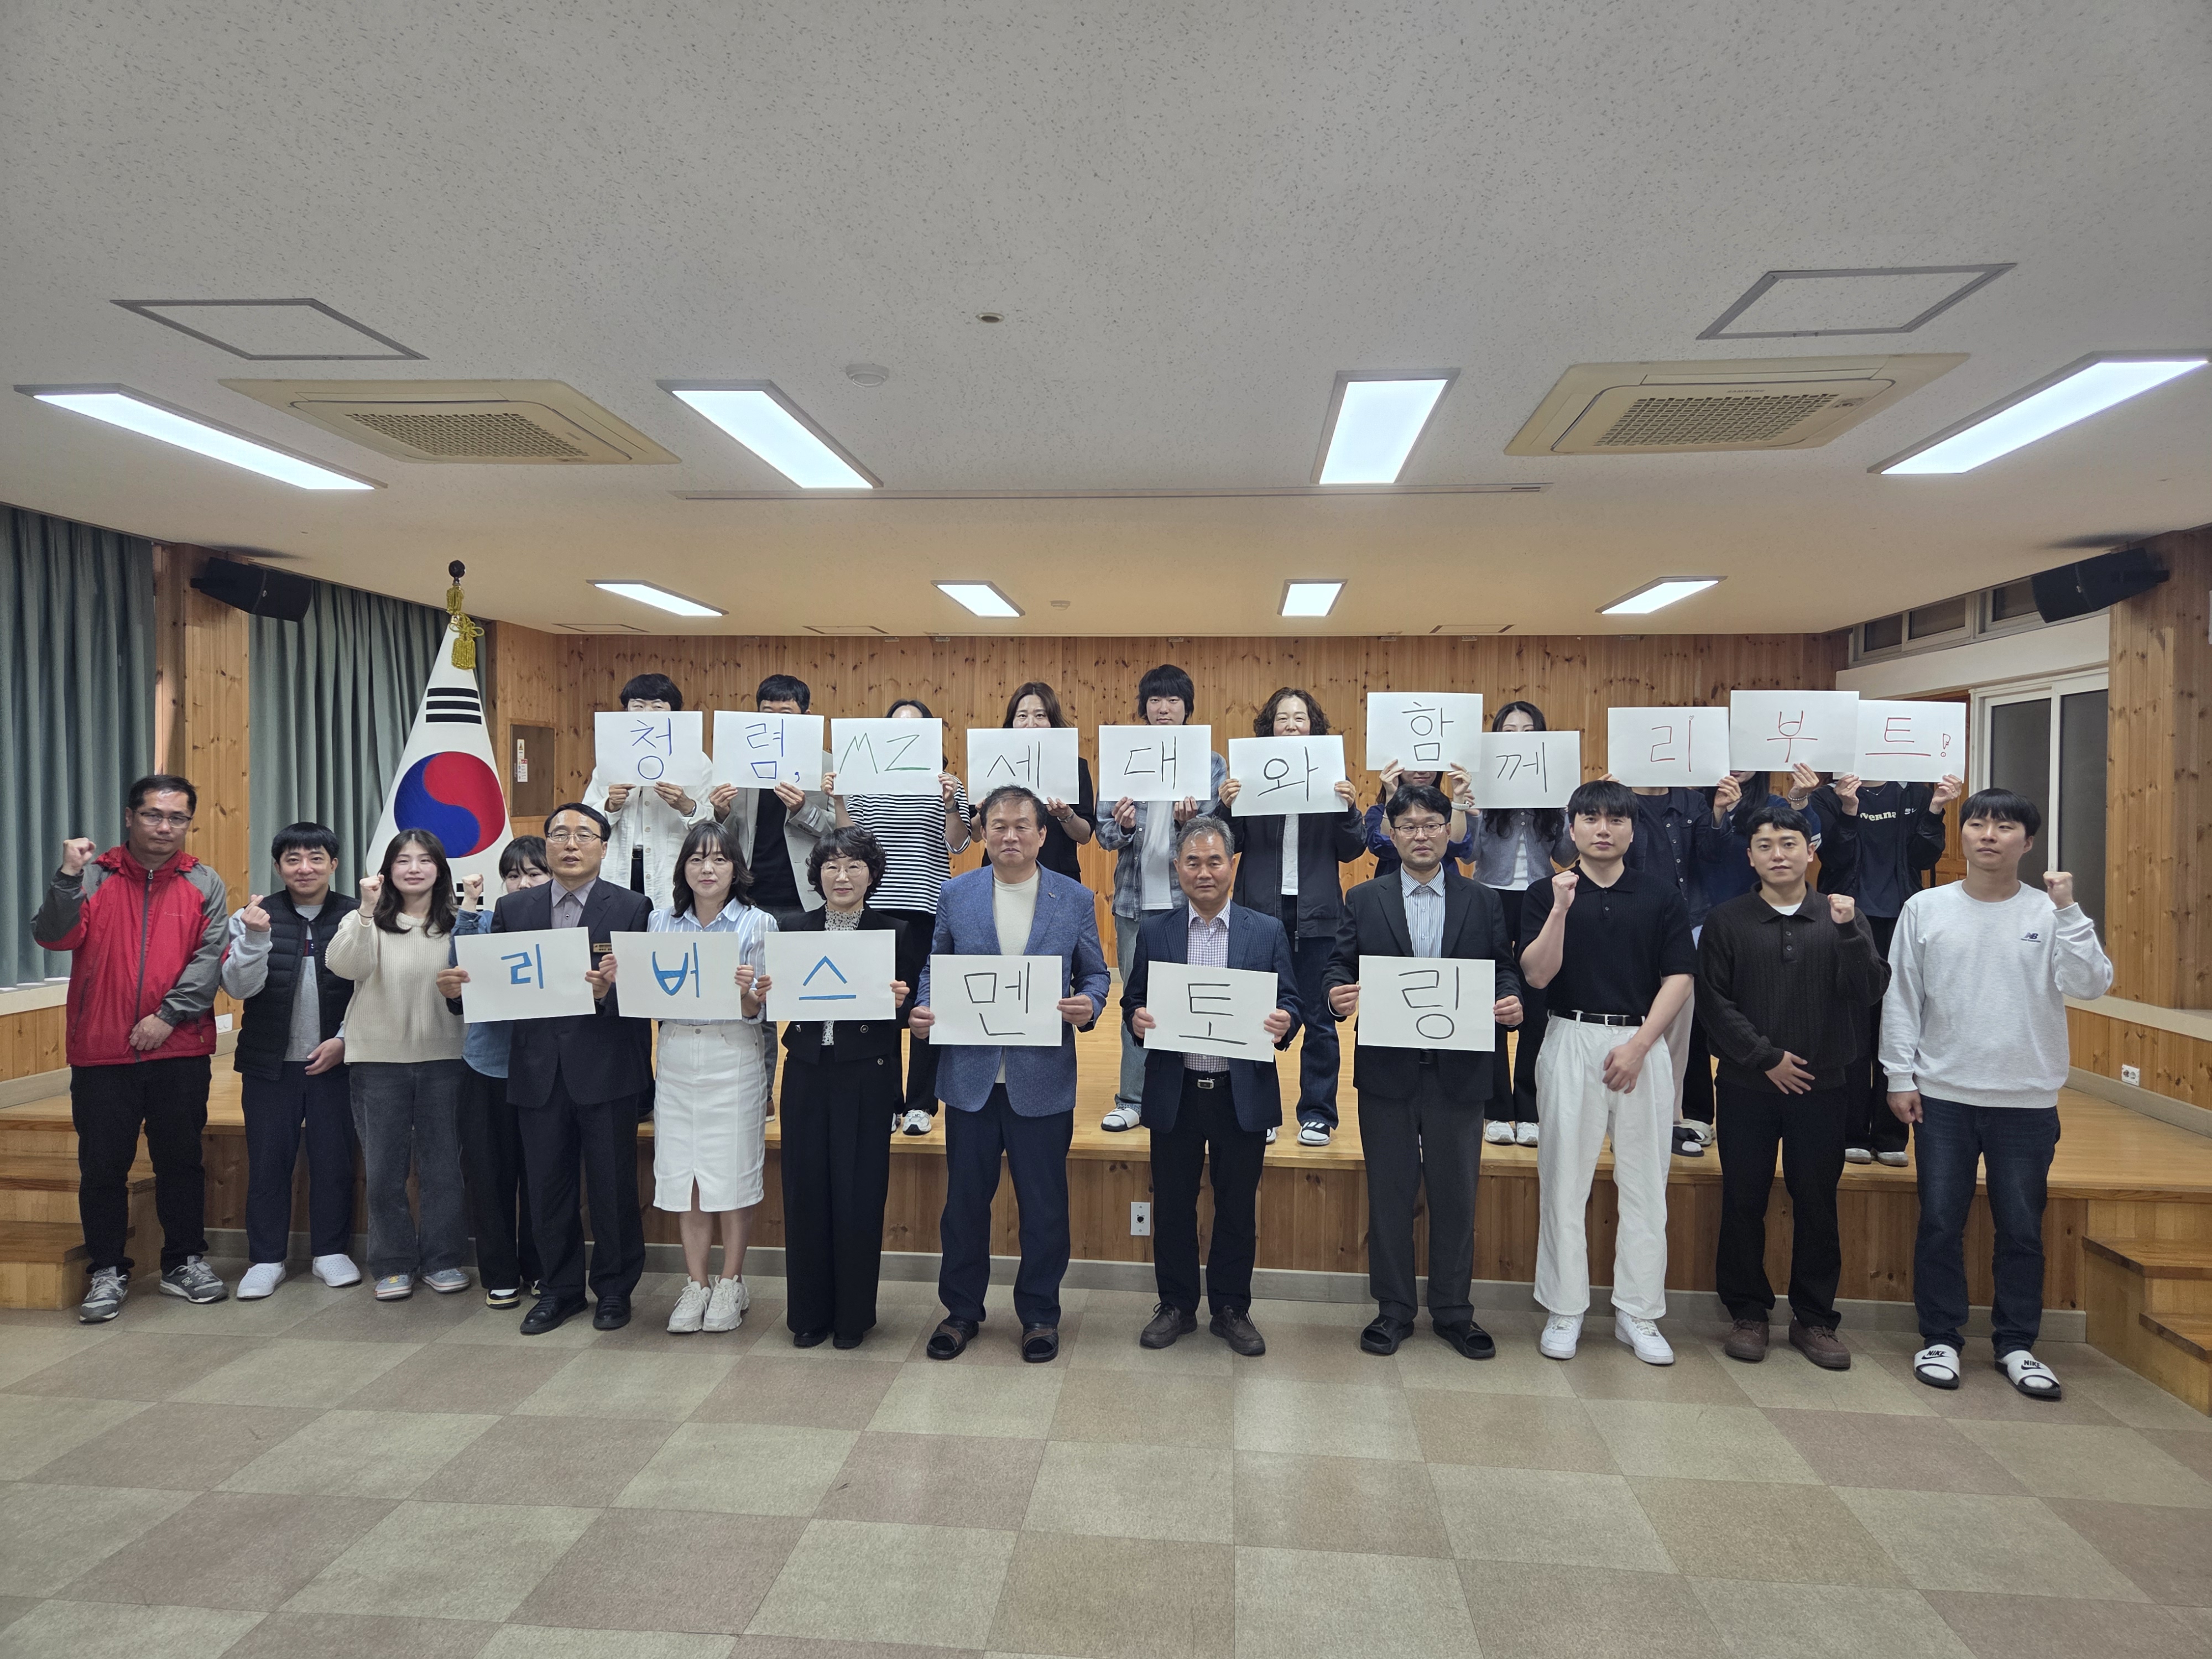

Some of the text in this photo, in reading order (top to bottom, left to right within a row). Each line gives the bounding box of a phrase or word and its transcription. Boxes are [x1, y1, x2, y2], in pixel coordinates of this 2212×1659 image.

[630, 717, 672, 780] 청
[745, 718, 800, 783] 렴,
[839, 732, 931, 774] MZ
[1401, 701, 1454, 761] 함
[1650, 717, 1692, 773] 리
[1766, 710, 1818, 763] 부
[1865, 717, 1951, 758] 트!
[987, 741, 1040, 789] 세
[1124, 735, 1176, 790] 대
[1257, 746, 1319, 802] 와
[1495, 742, 1547, 793] 께
[500, 943, 544, 989] 리
[651, 942, 700, 998] 버
[799, 955, 857, 1001] 스
[963, 962, 1030, 1036] 멘
[1178, 983, 1248, 1045] 토
[1397, 966, 1459, 1040] 링
[2024, 1360, 2041, 1369] NIKE
